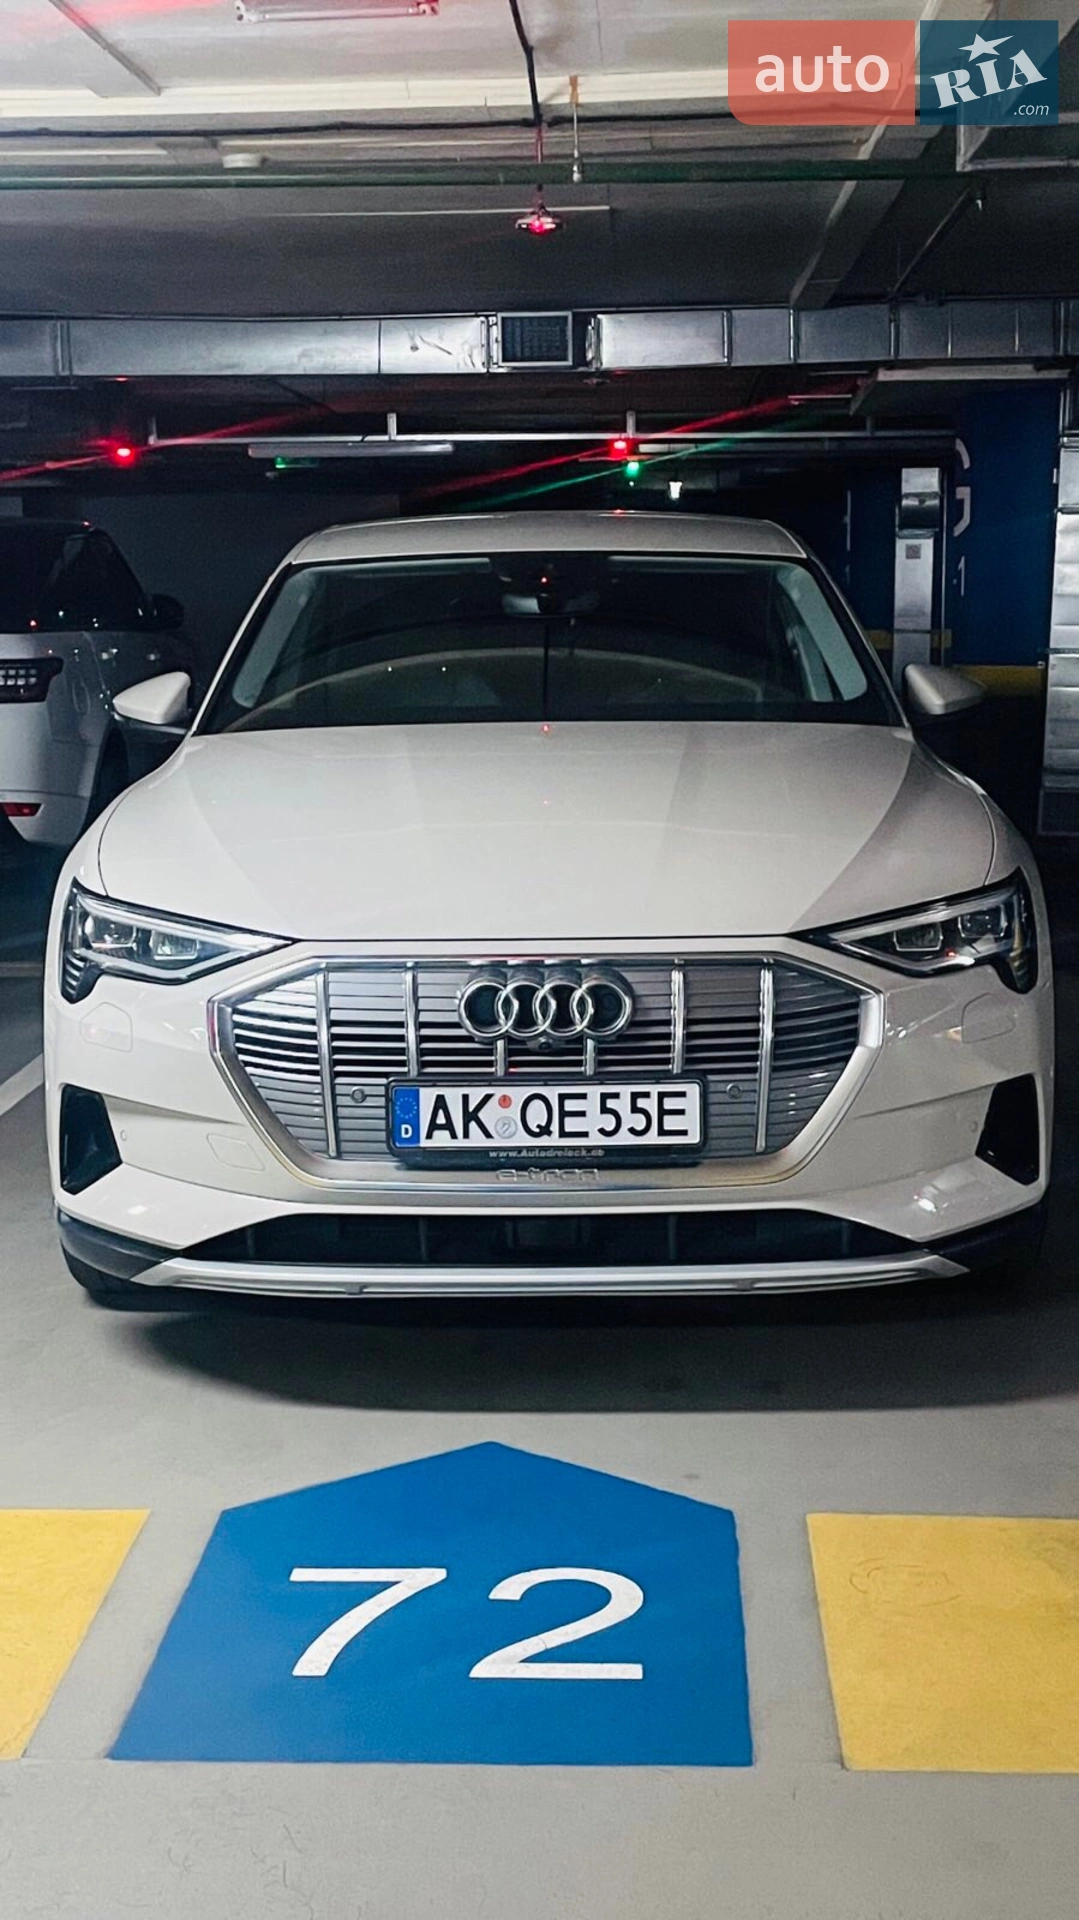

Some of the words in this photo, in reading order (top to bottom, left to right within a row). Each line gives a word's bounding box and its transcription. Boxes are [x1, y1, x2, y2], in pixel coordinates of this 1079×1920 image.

[401, 1124, 413, 1138] D
[425, 1093, 495, 1140] AK
[290, 1567, 644, 1680] 72
